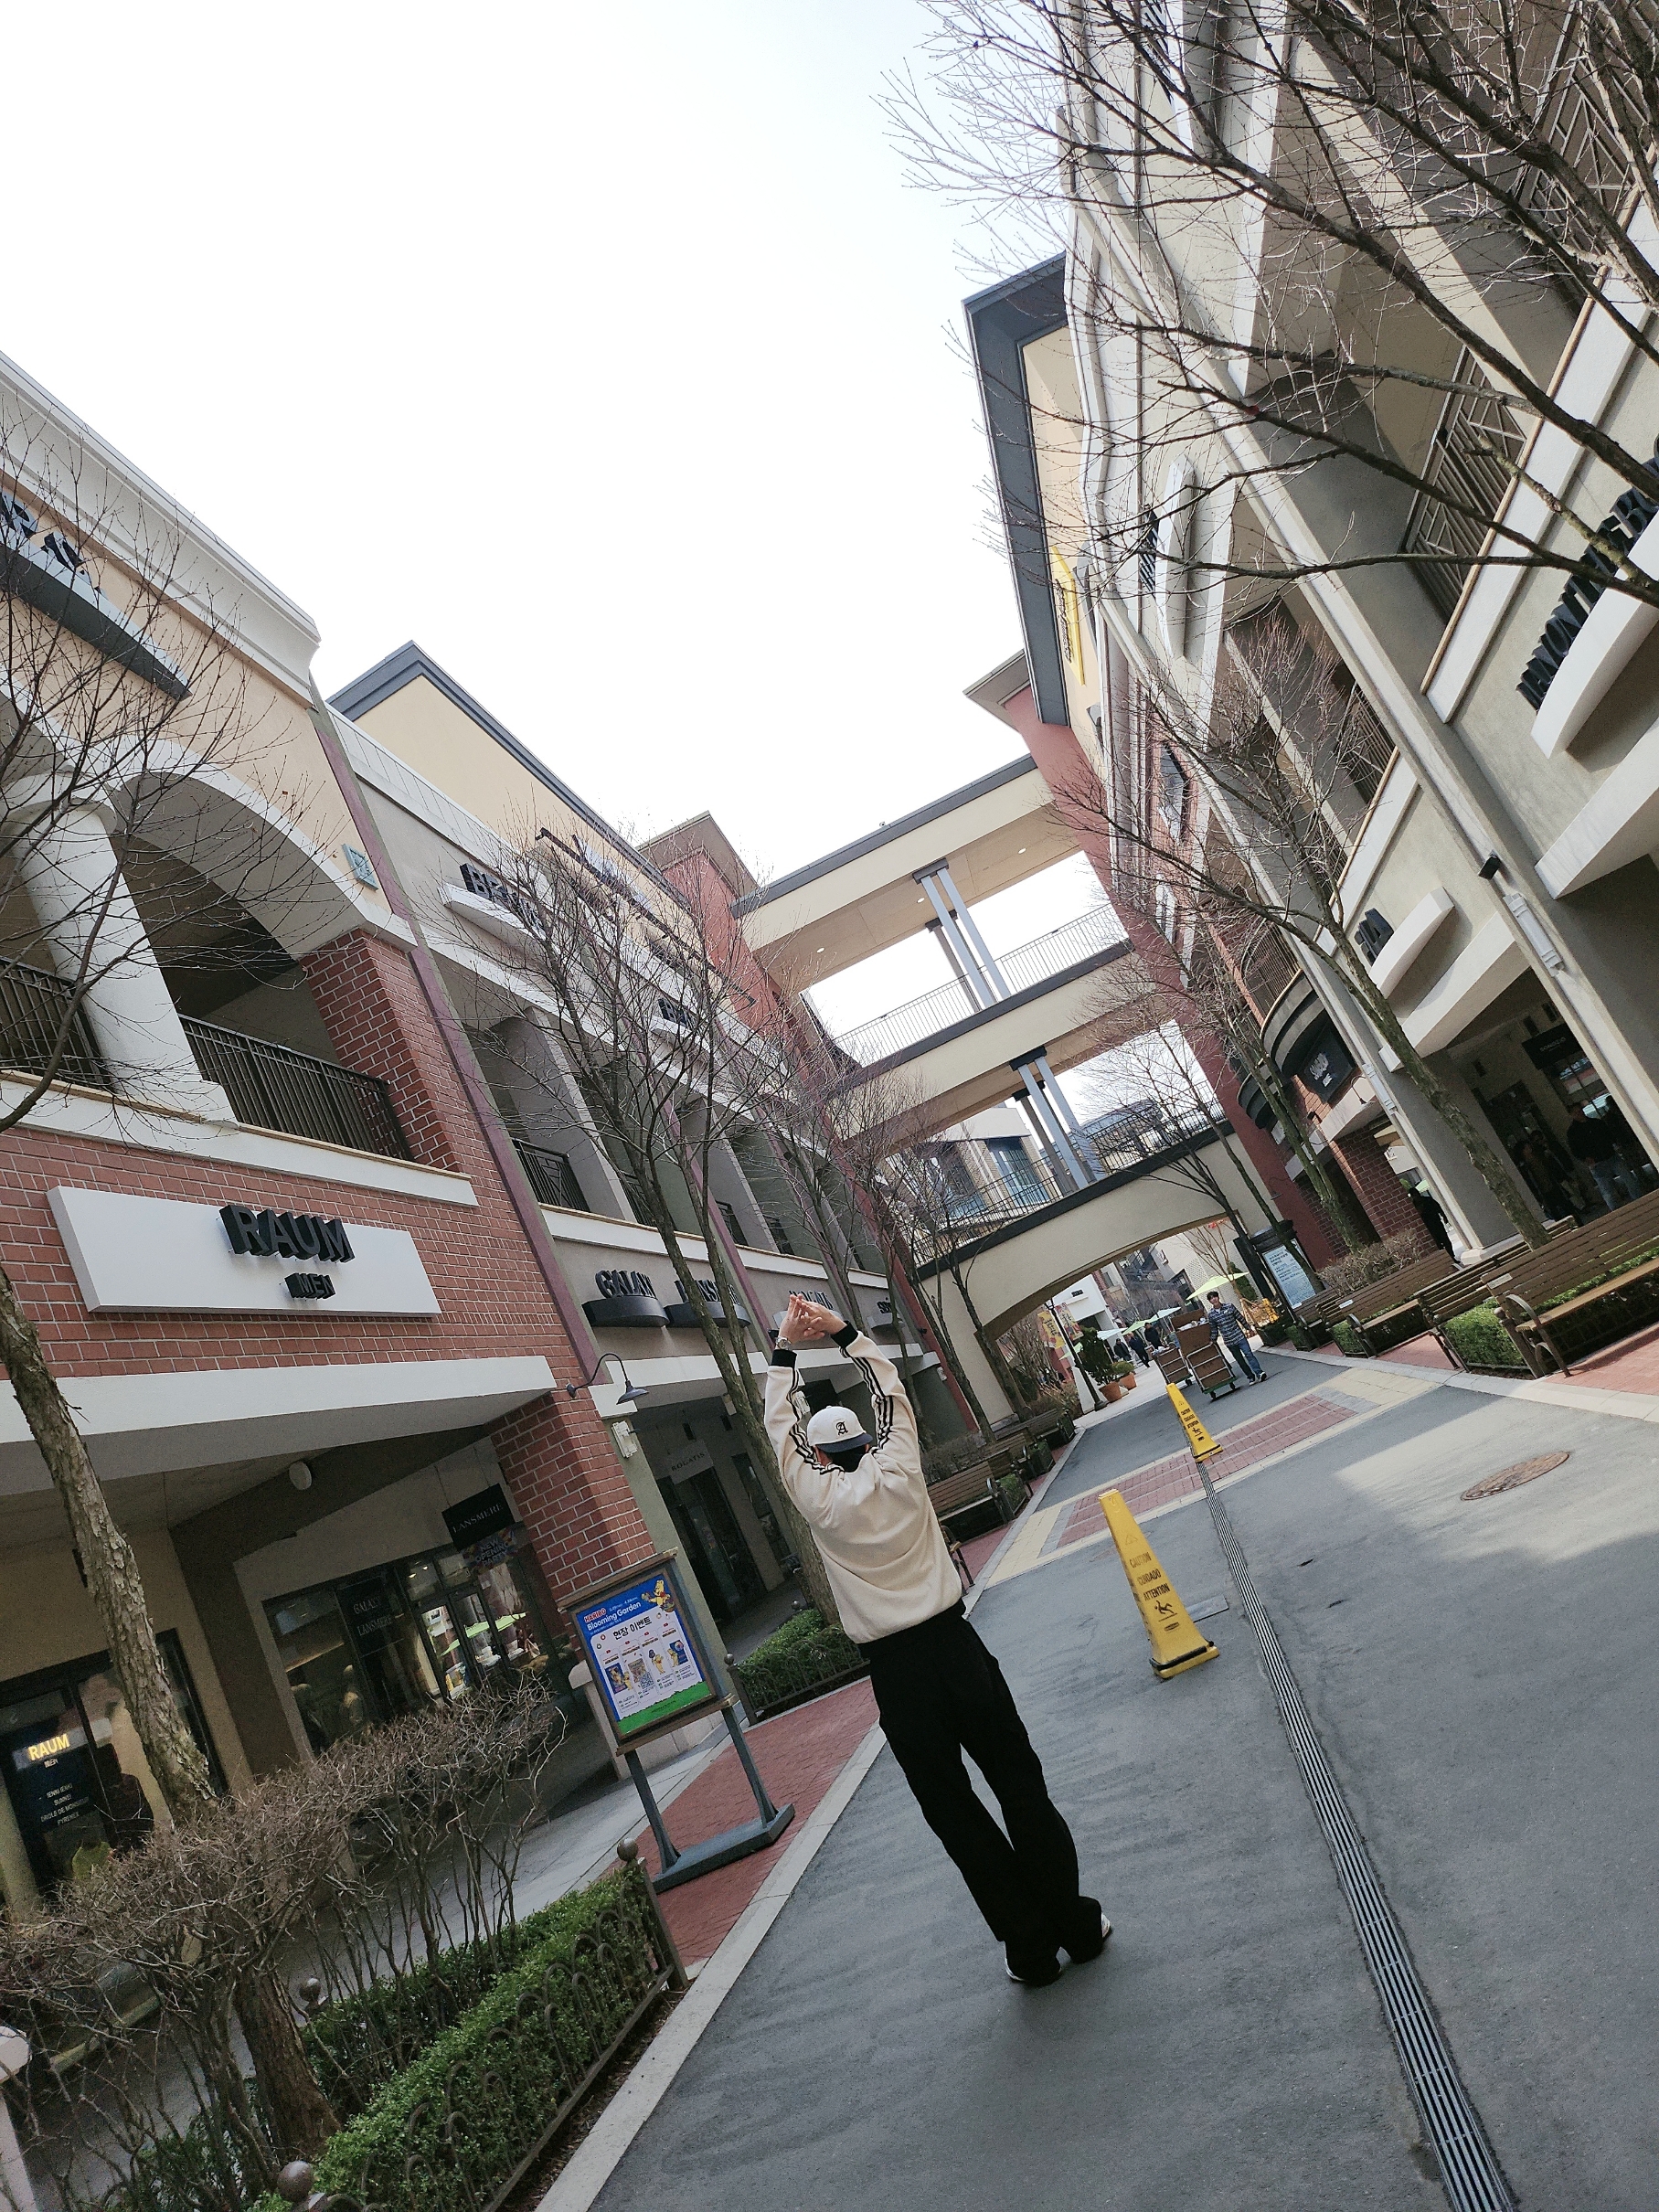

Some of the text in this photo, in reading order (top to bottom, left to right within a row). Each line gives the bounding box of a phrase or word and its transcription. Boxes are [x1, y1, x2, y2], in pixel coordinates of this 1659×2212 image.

[219, 1205, 356, 1263] RAUM
[284, 1273, 336, 1300] MEN
[476, 1541, 509, 1561] OPENING
[480, 1537, 500, 1552] NEW
[1129, 1551, 1152, 1569] CAUTION
[1137, 1569, 1162, 1586] CUIDADO
[1143, 1582, 1171, 1601] ATTENTION
[584, 1608, 607, 1623] HARIBO
[617, 1601, 642, 1616] Garden
[587, 1612, 617, 1631] Blooming
[612, 1626, 629, 1641] 현장
[629, 1616, 653, 1632] 이벤트
[27, 1733, 70, 1761] RAUM
